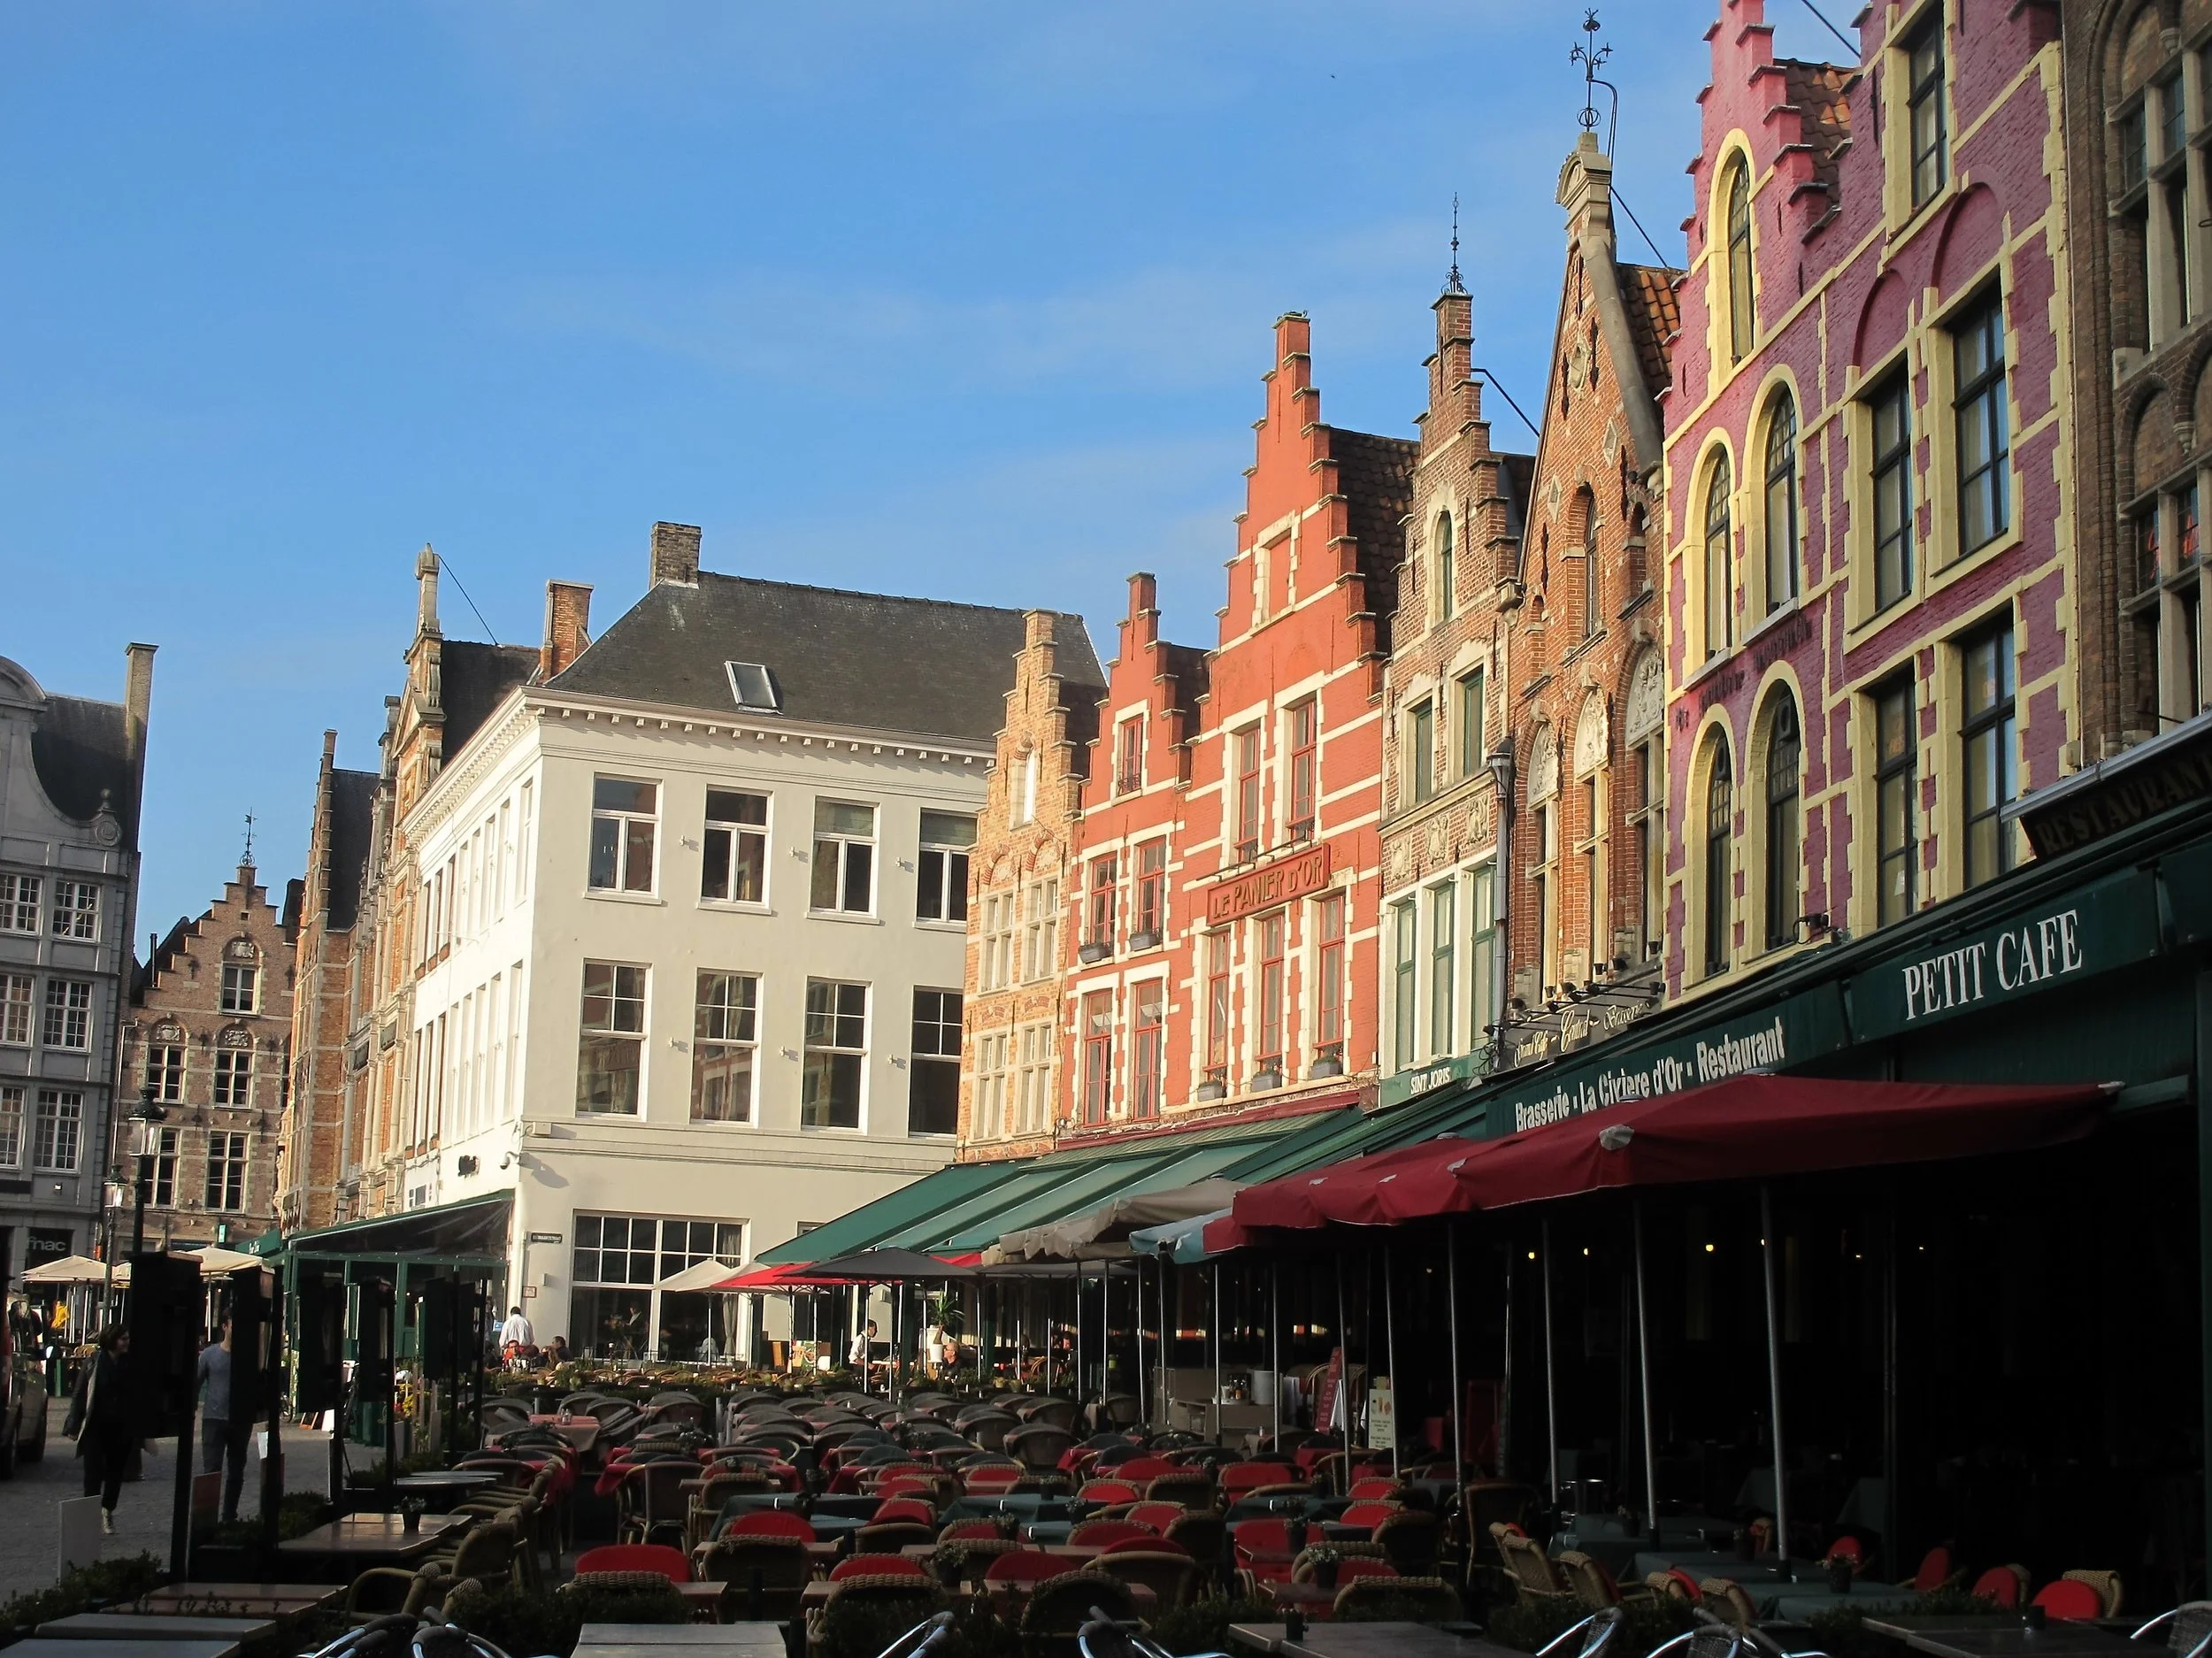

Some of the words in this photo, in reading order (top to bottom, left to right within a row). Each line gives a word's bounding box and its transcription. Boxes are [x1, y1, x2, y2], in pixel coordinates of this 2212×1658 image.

[1213, 894, 1231, 919] LE
[1233, 869, 1285, 912] PANIER
[1287, 856, 1323, 894] D'OR
[1901, 941, 1986, 1021] PETIT
[1995, 909, 2083, 991] CAFE
[1410, 1072, 1428, 1095] SINT
[1428, 1066, 1451, 1090] JORIS
[1515, 1085, 1570, 1133] Brasserie
[1578, 1081, 1597, 1114] La
[1652, 1055, 1684, 1096] d'Or
[1695, 1016, 1786, 1084] Restaurant
